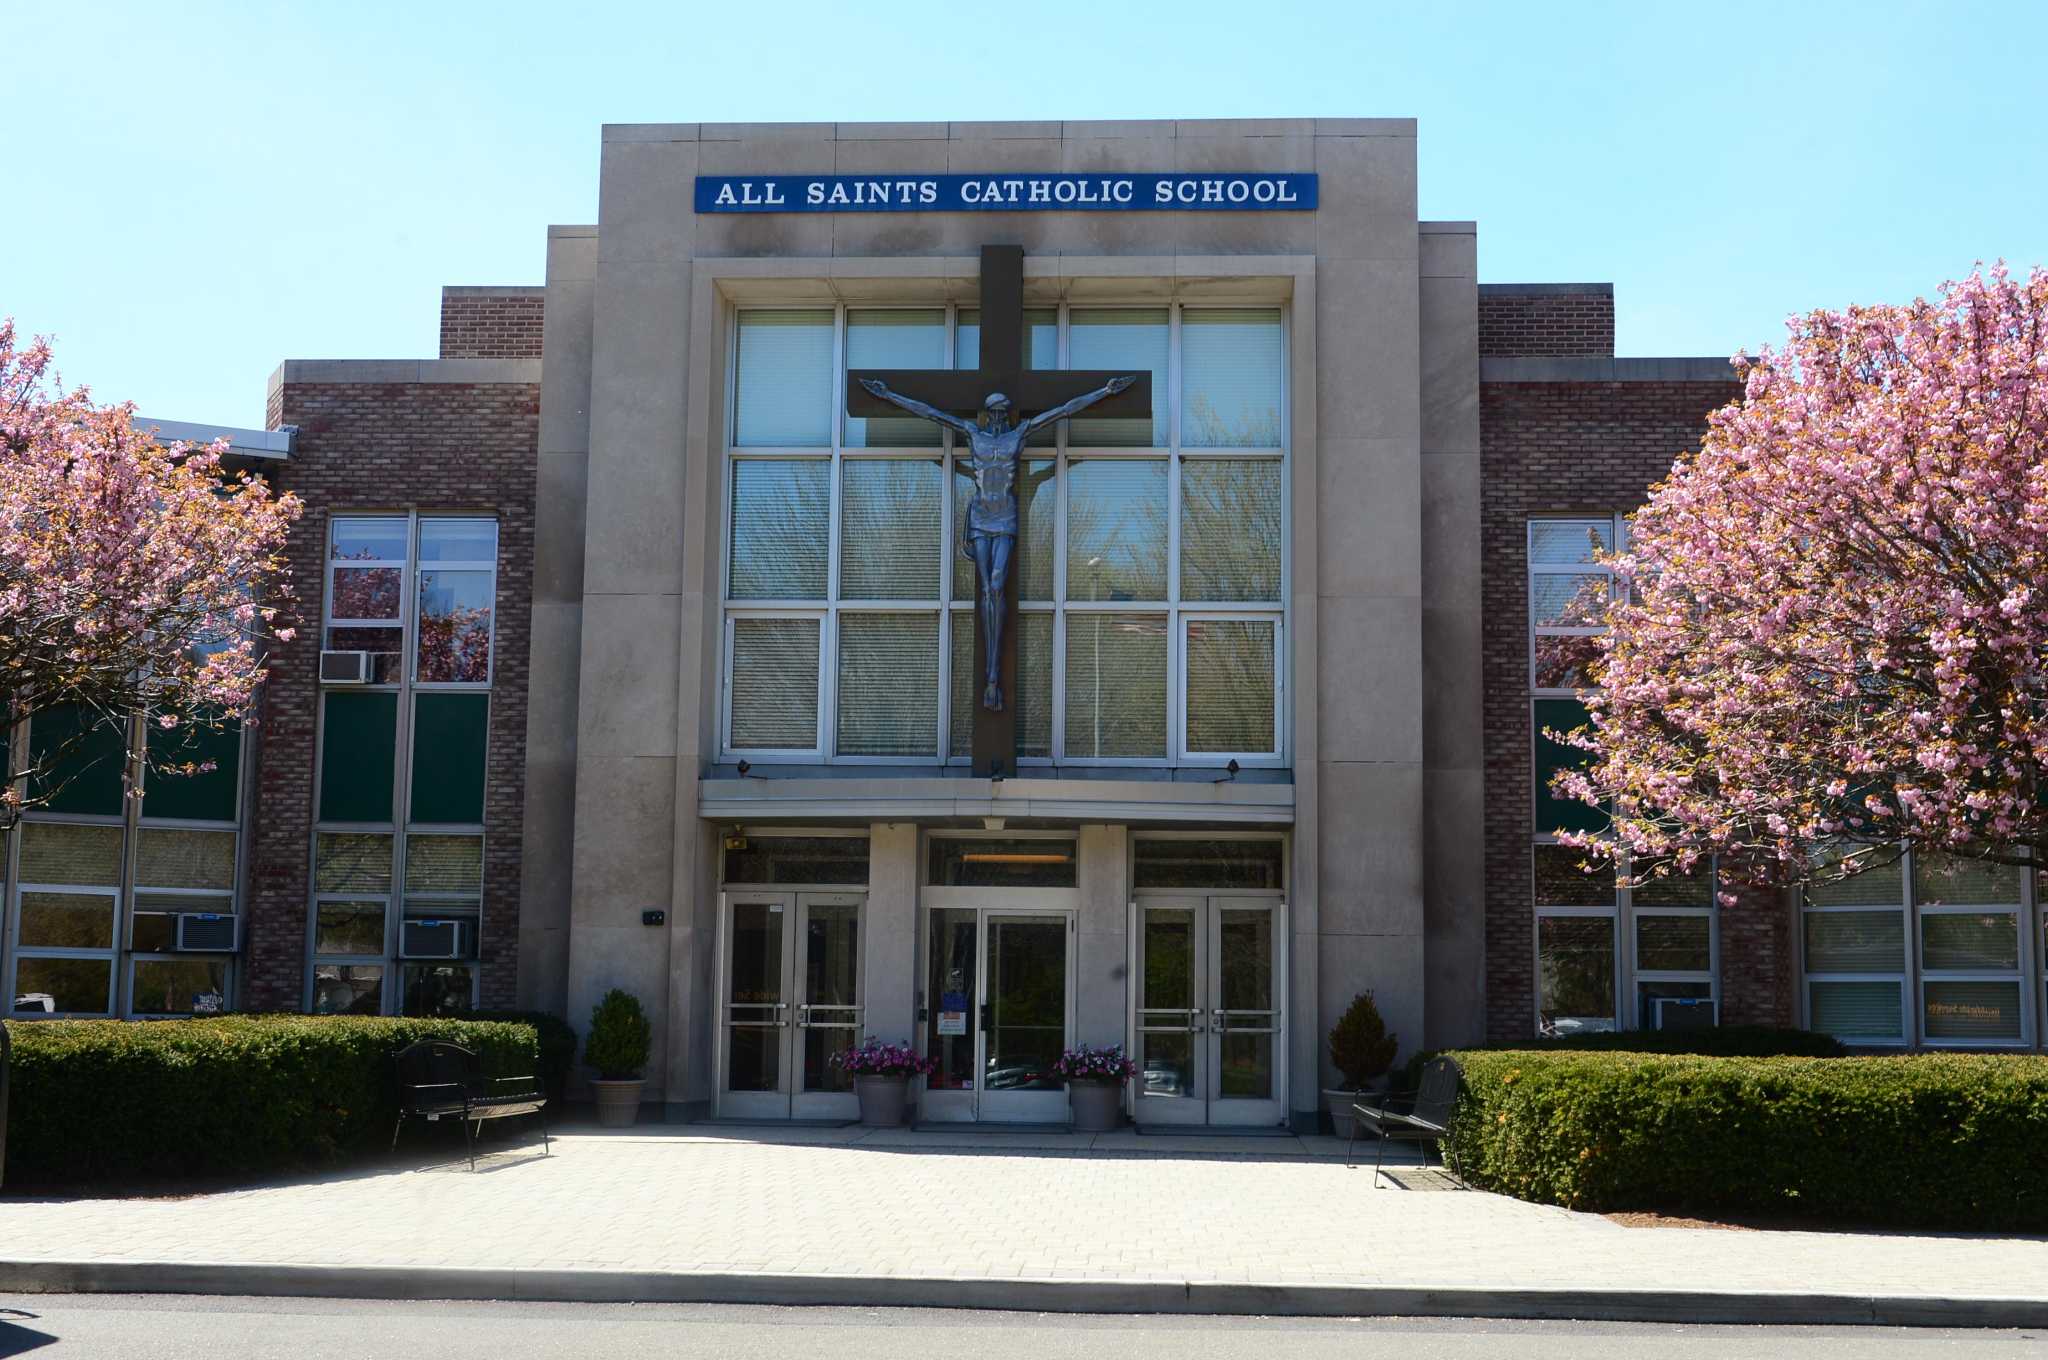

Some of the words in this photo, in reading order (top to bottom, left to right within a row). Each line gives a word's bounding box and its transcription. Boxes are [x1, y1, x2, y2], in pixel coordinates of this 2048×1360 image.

[715, 183, 785, 204] ALL
[807, 181, 938, 204] SAINTS
[960, 180, 1134, 202] CATHOLIC
[1155, 180, 1297, 202] SCHOOL
